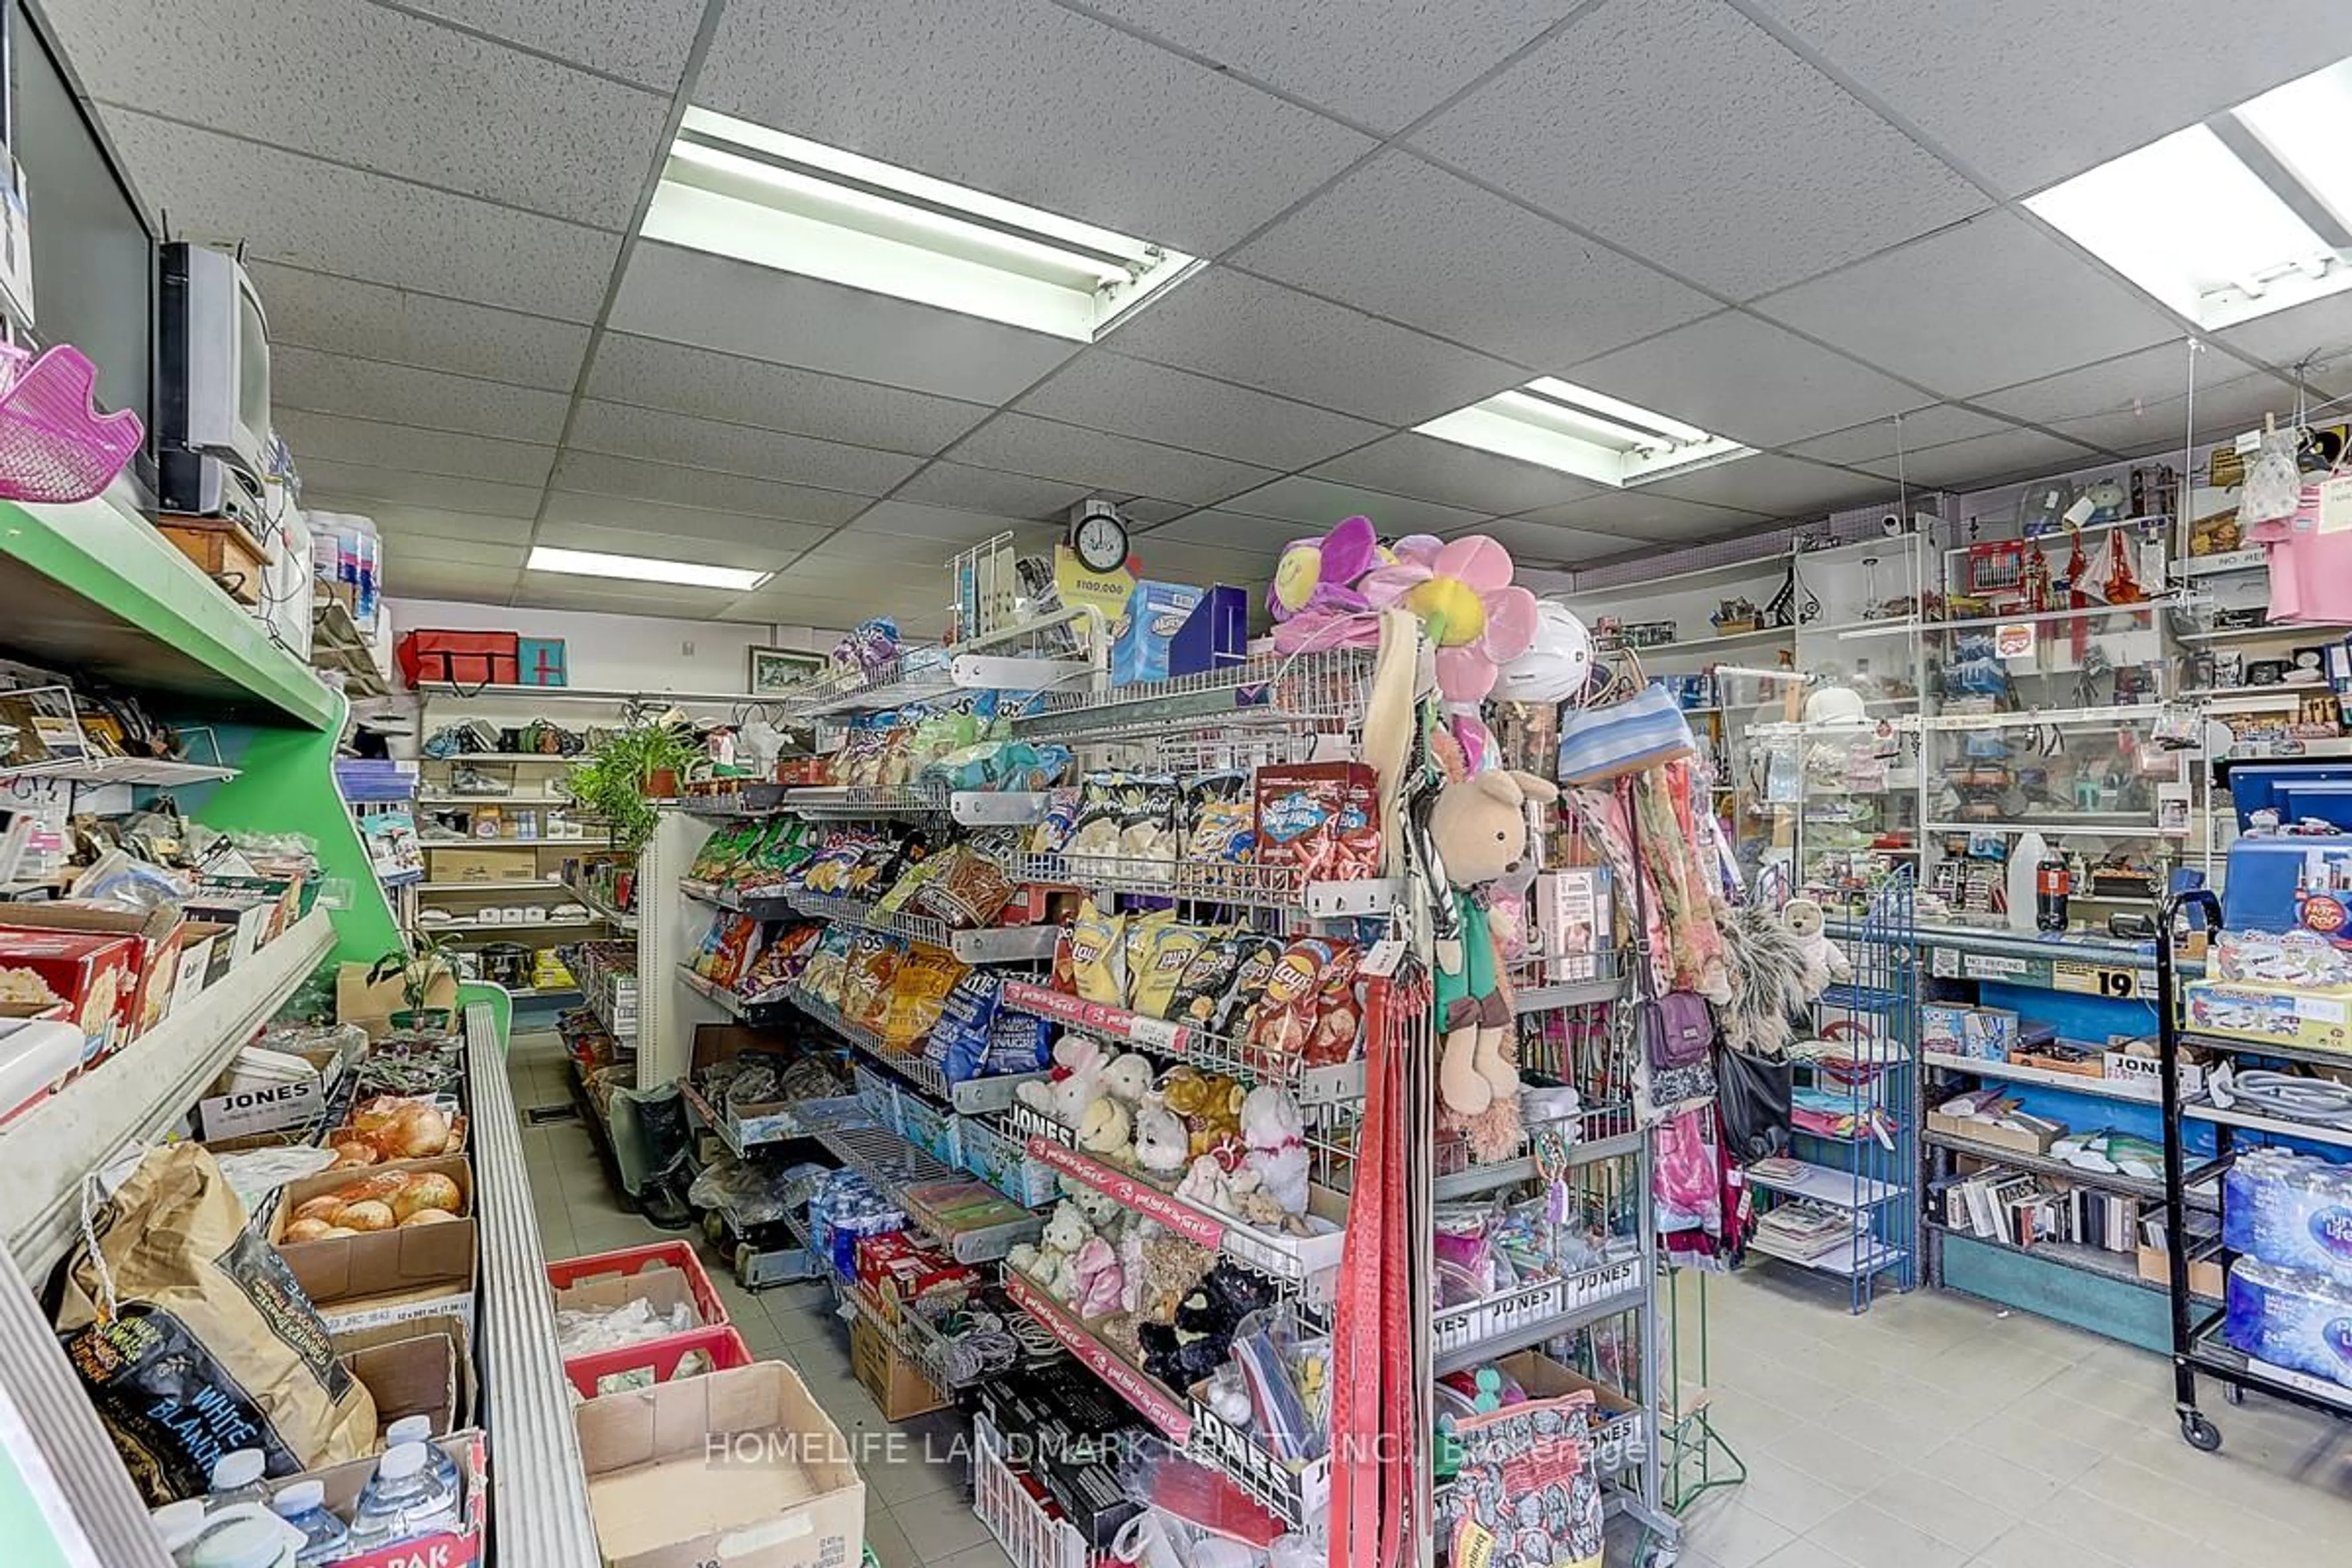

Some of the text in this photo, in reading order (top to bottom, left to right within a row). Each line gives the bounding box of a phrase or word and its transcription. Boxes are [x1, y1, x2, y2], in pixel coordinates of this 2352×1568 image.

[1272, 959, 1315, 997] Lay's
[2097, 971, 2132, 996] 19
[223, 1082, 309, 1112] JONES
[1012, 1103, 1071, 1149] JONES
[1578, 1262, 1630, 1291] JONES
[1492, 1290, 1551, 1317] JONES
[192, 1383, 258, 1448] WHITE
[146, 1397, 222, 1480] BLANCH
[1192, 1400, 1291, 1494] JONES
[1589, 1421, 1632, 1451] ONES
